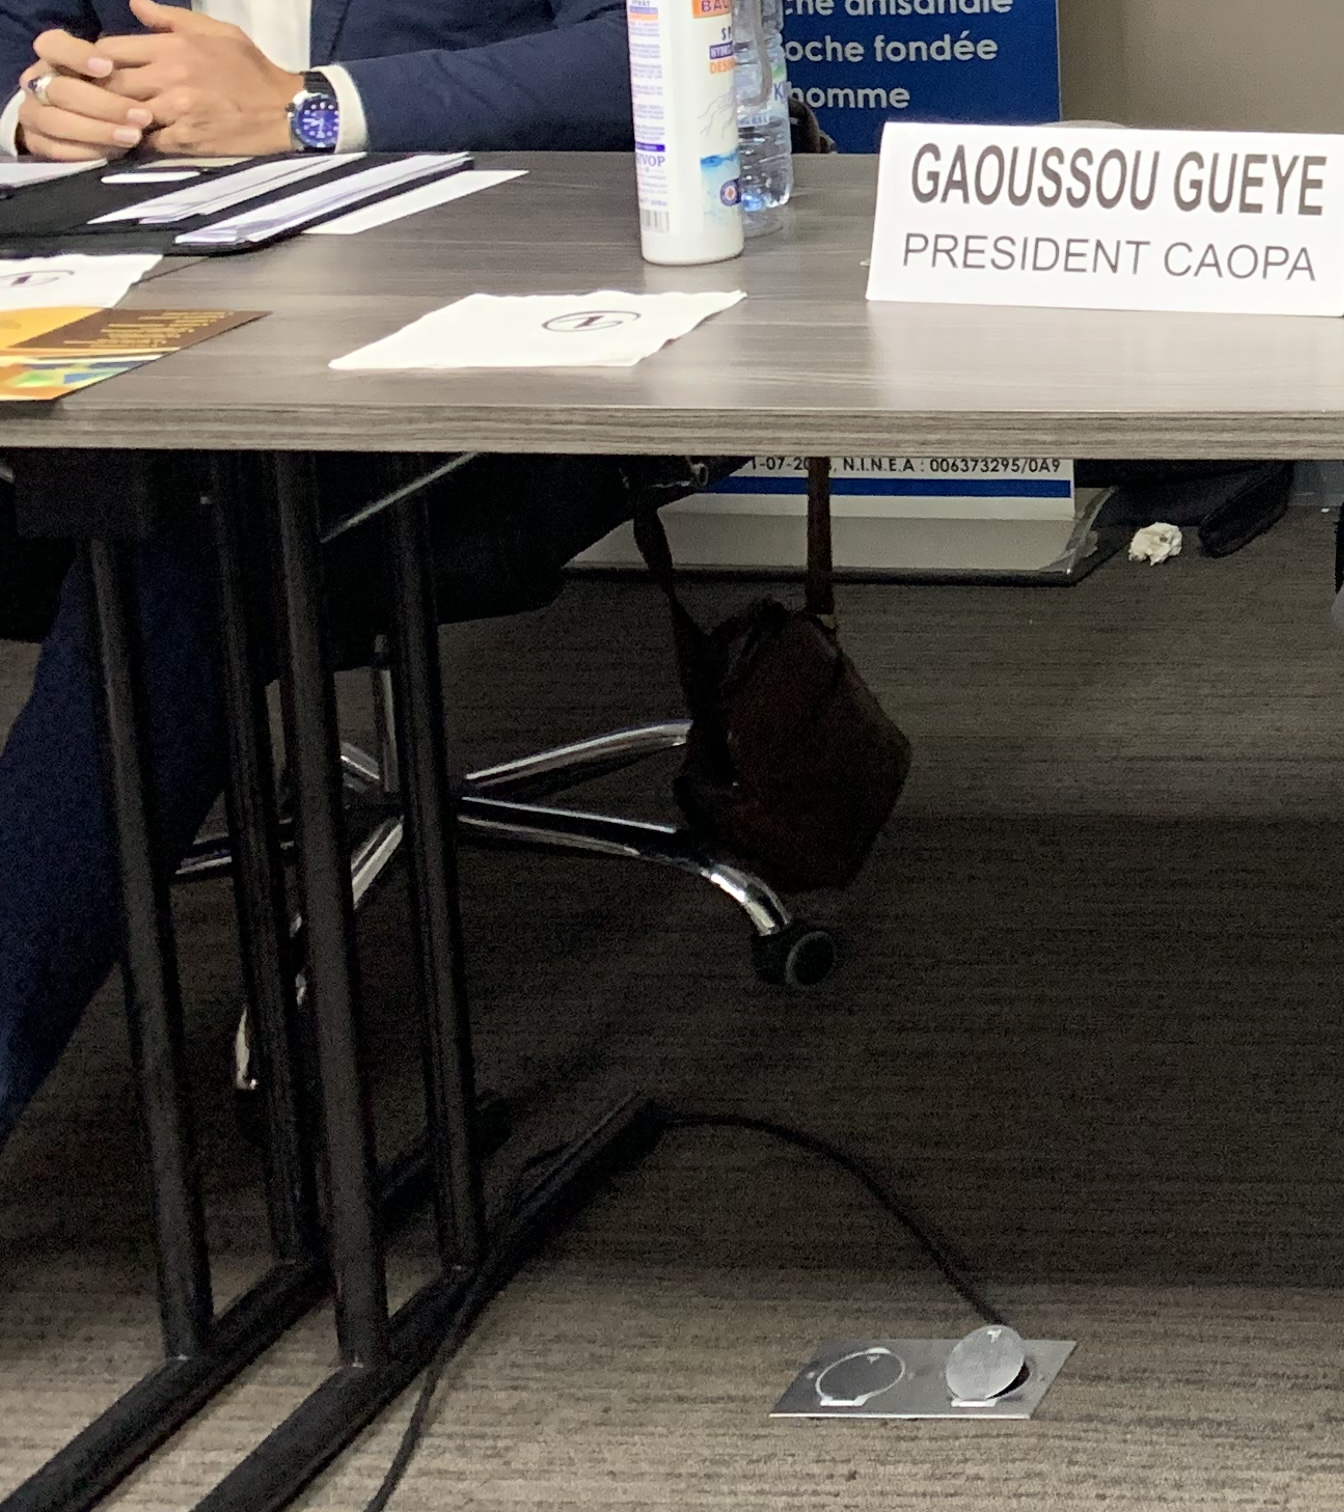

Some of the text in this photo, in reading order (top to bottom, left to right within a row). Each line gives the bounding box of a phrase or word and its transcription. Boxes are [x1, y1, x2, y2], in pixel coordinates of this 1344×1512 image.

[874, 30, 997, 62] fondée
[912, 143, 1326, 216] GAOUSSOU GUEYE
[904, 233, 1315, 281] PRESIDENT CAOPA
